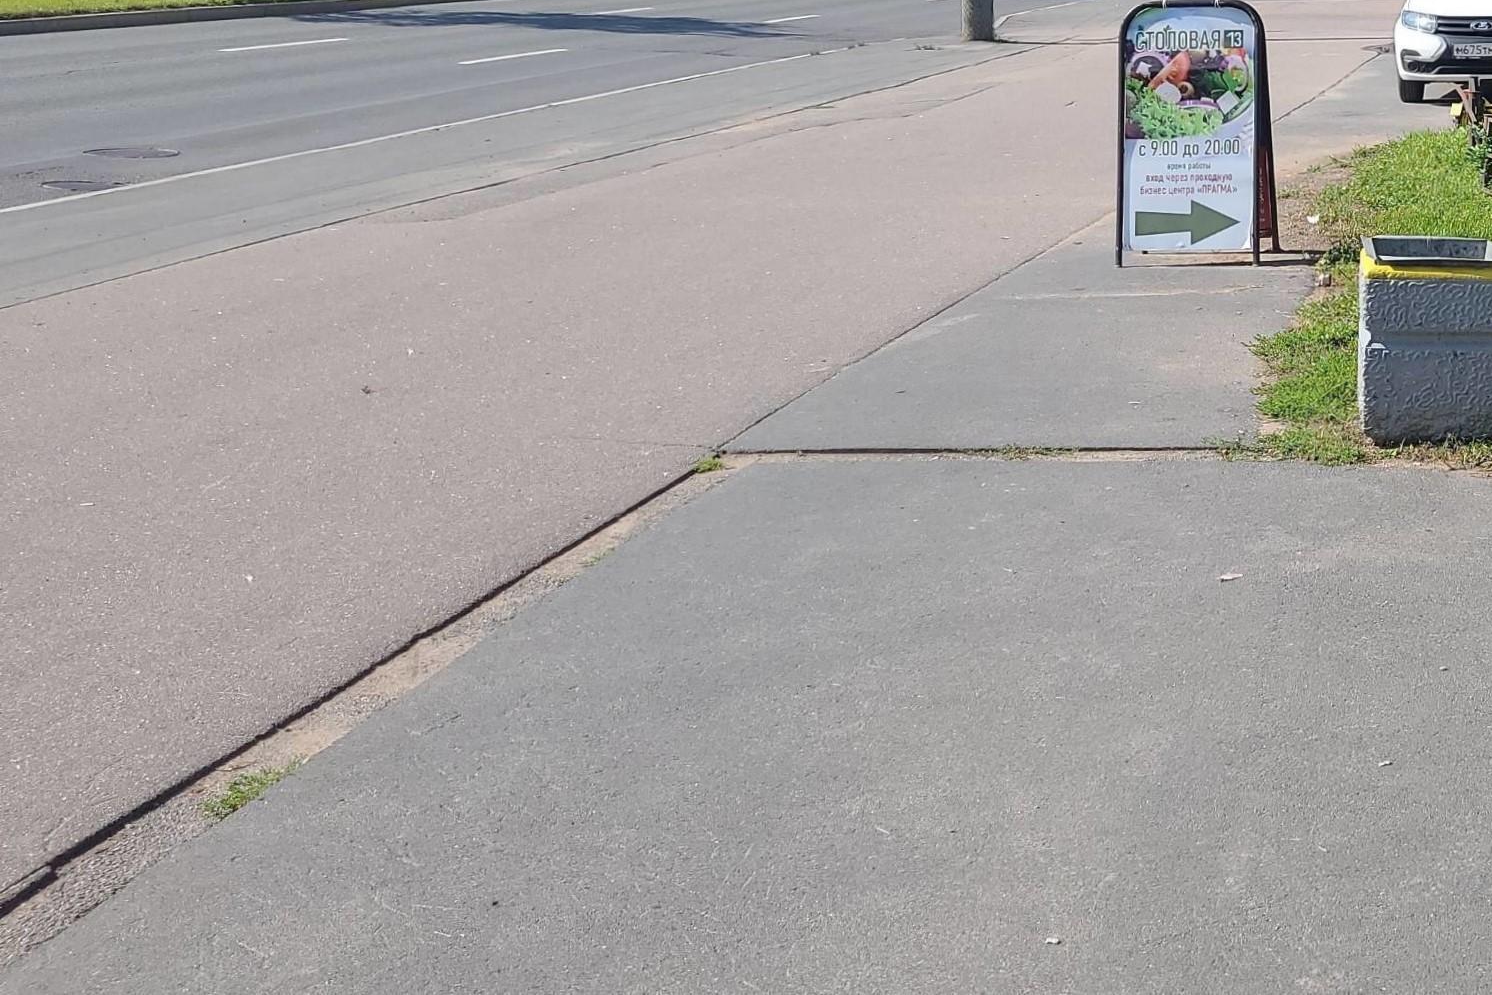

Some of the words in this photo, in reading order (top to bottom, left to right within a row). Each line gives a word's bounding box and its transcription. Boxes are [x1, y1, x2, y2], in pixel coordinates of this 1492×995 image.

[1135, 30, 1221, 50] СТОЛОВАЯ
[1226, 32, 1242, 47] 13
[1183, 144, 1199, 157] до
[1145, 174, 1164, 183] вход
[1166, 174, 1188, 184] через
[1190, 173, 1233, 182] проходную
[1168, 186, 1195, 196] центра
